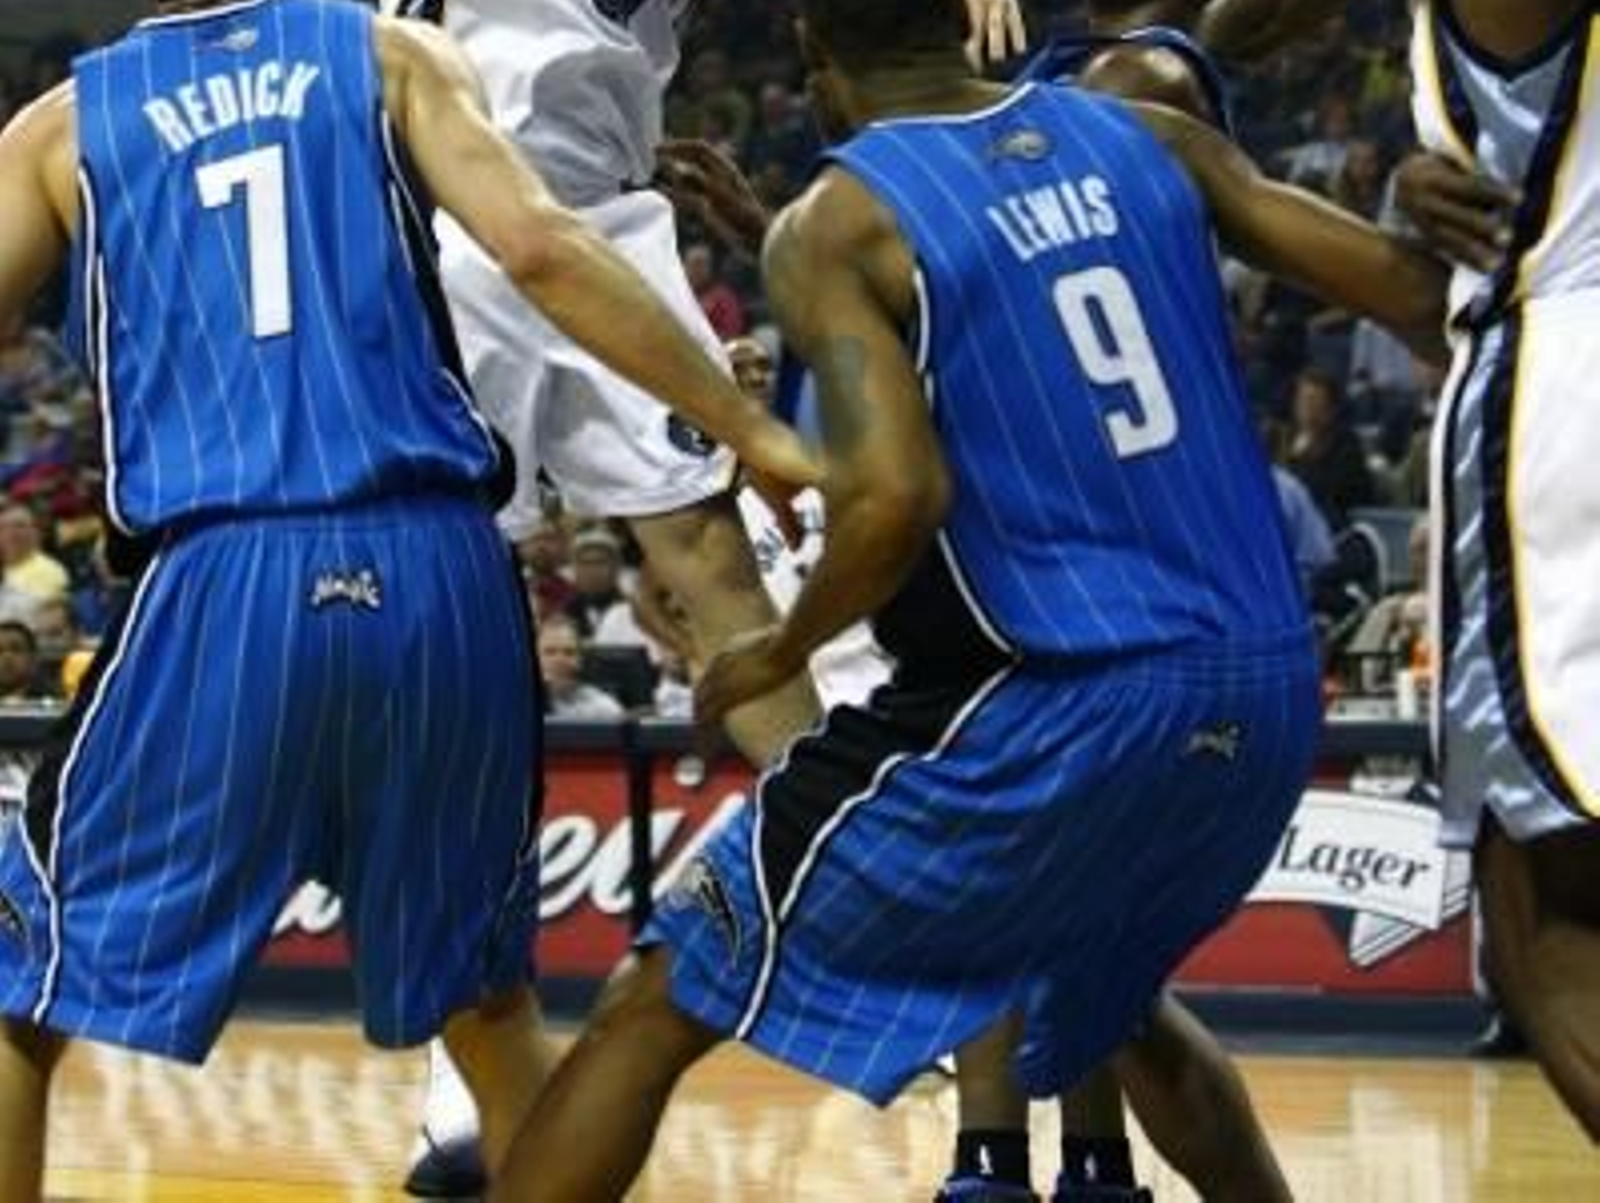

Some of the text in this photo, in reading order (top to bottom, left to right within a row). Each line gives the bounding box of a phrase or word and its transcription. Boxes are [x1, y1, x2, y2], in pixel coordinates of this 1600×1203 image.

[143, 60, 321, 154] REDICK
[195, 143, 293, 338] 7
[1053, 265, 1178, 460] 9
[1278, 824, 1432, 892] Lager
